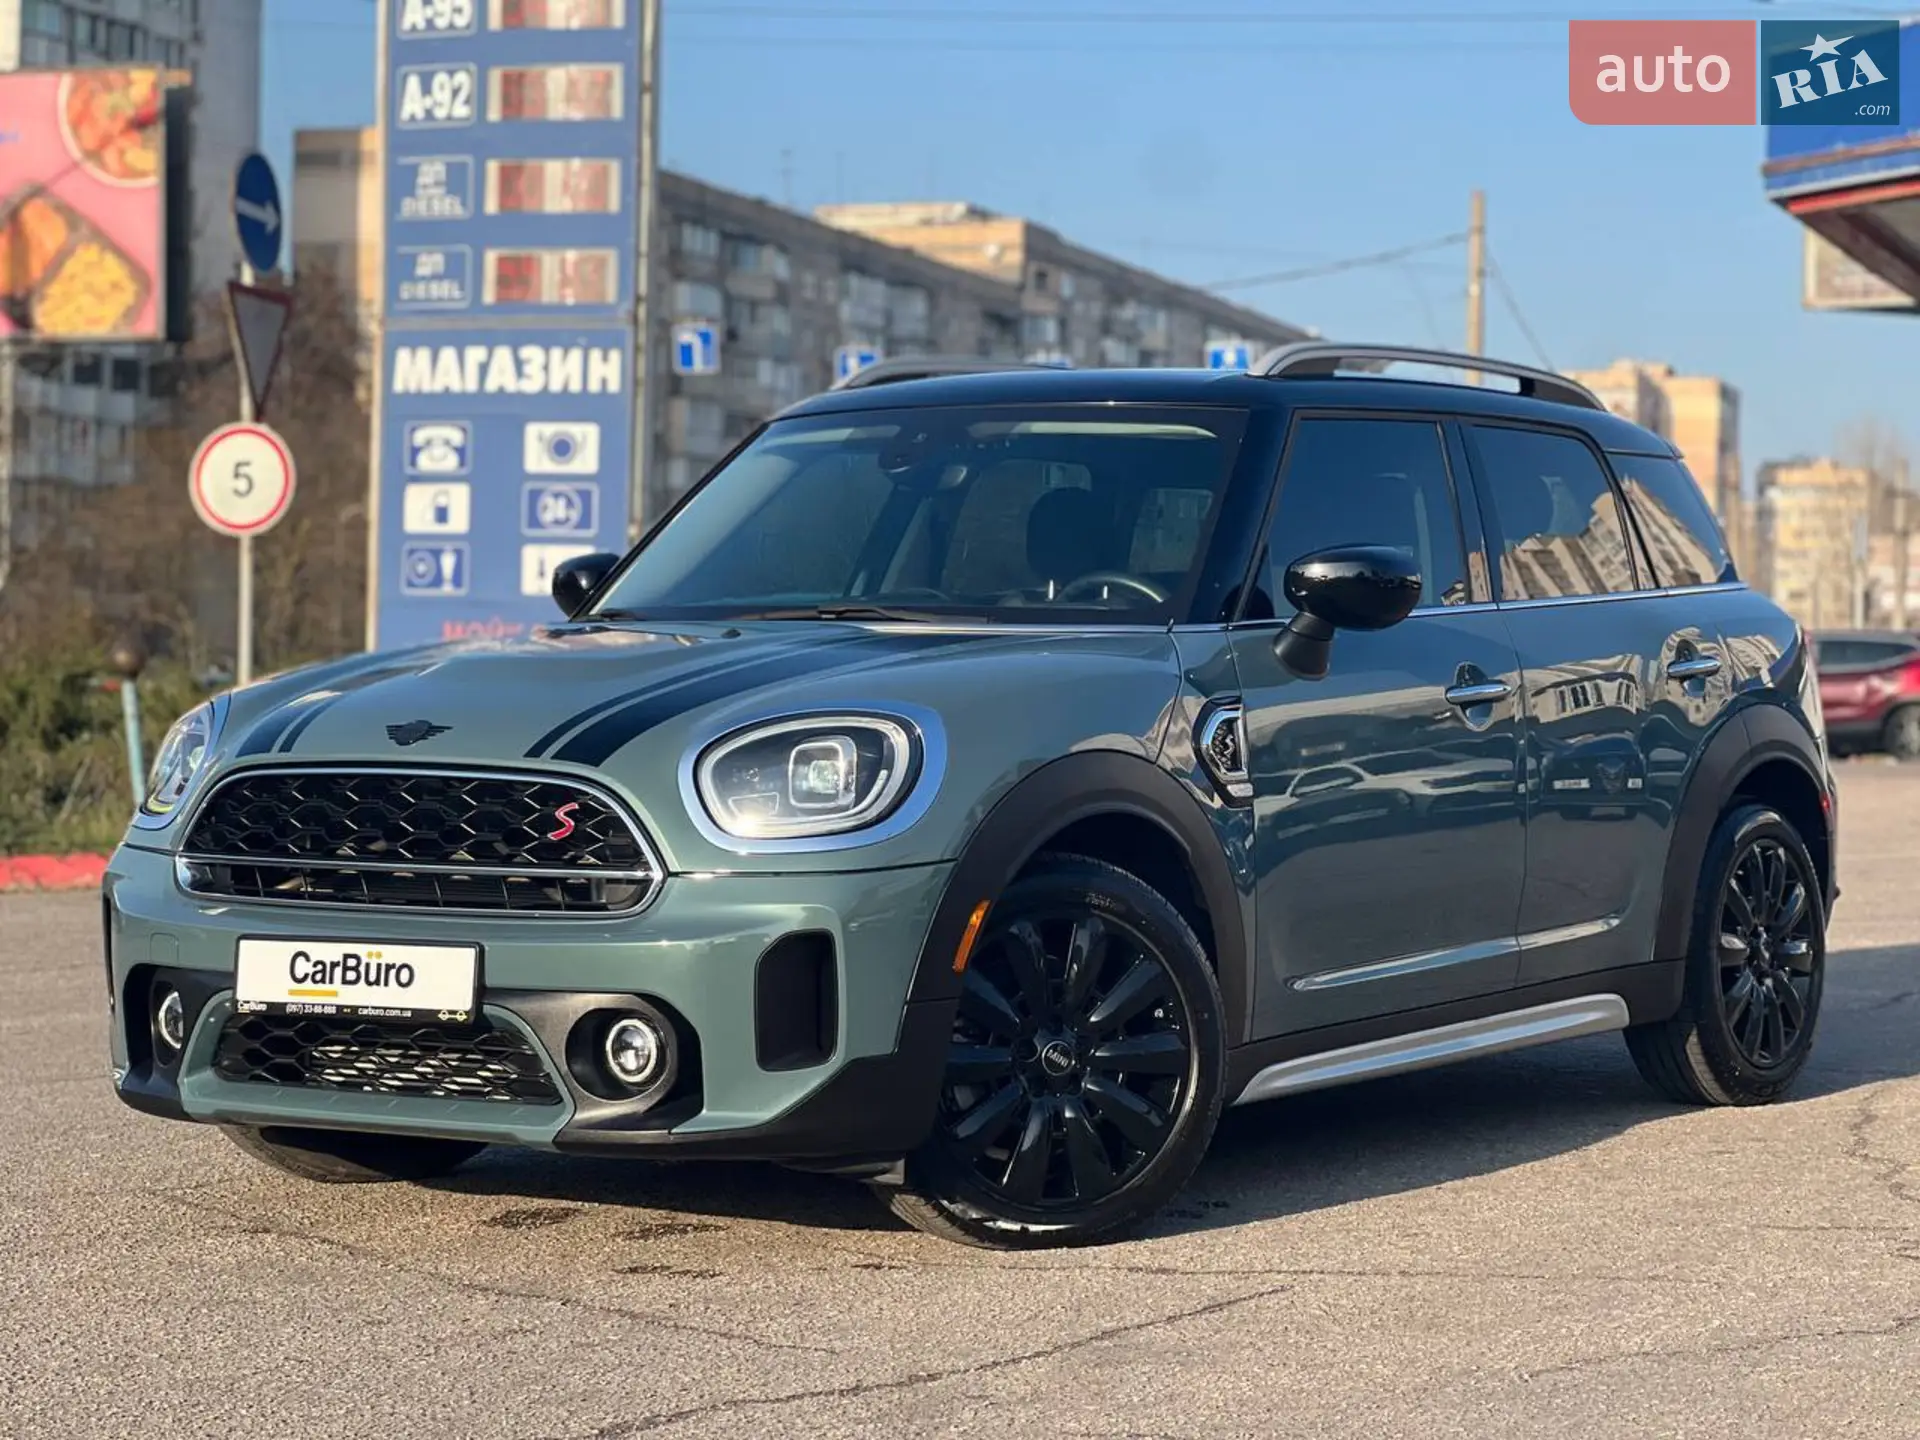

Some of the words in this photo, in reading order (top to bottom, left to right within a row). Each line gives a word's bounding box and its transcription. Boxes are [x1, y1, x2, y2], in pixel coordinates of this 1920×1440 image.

[392, 345, 623, 394] МАГАЗИН
[232, 461, 254, 497] 5
[547, 802, 579, 841] S
[289, 950, 415, 989] CarBüro
